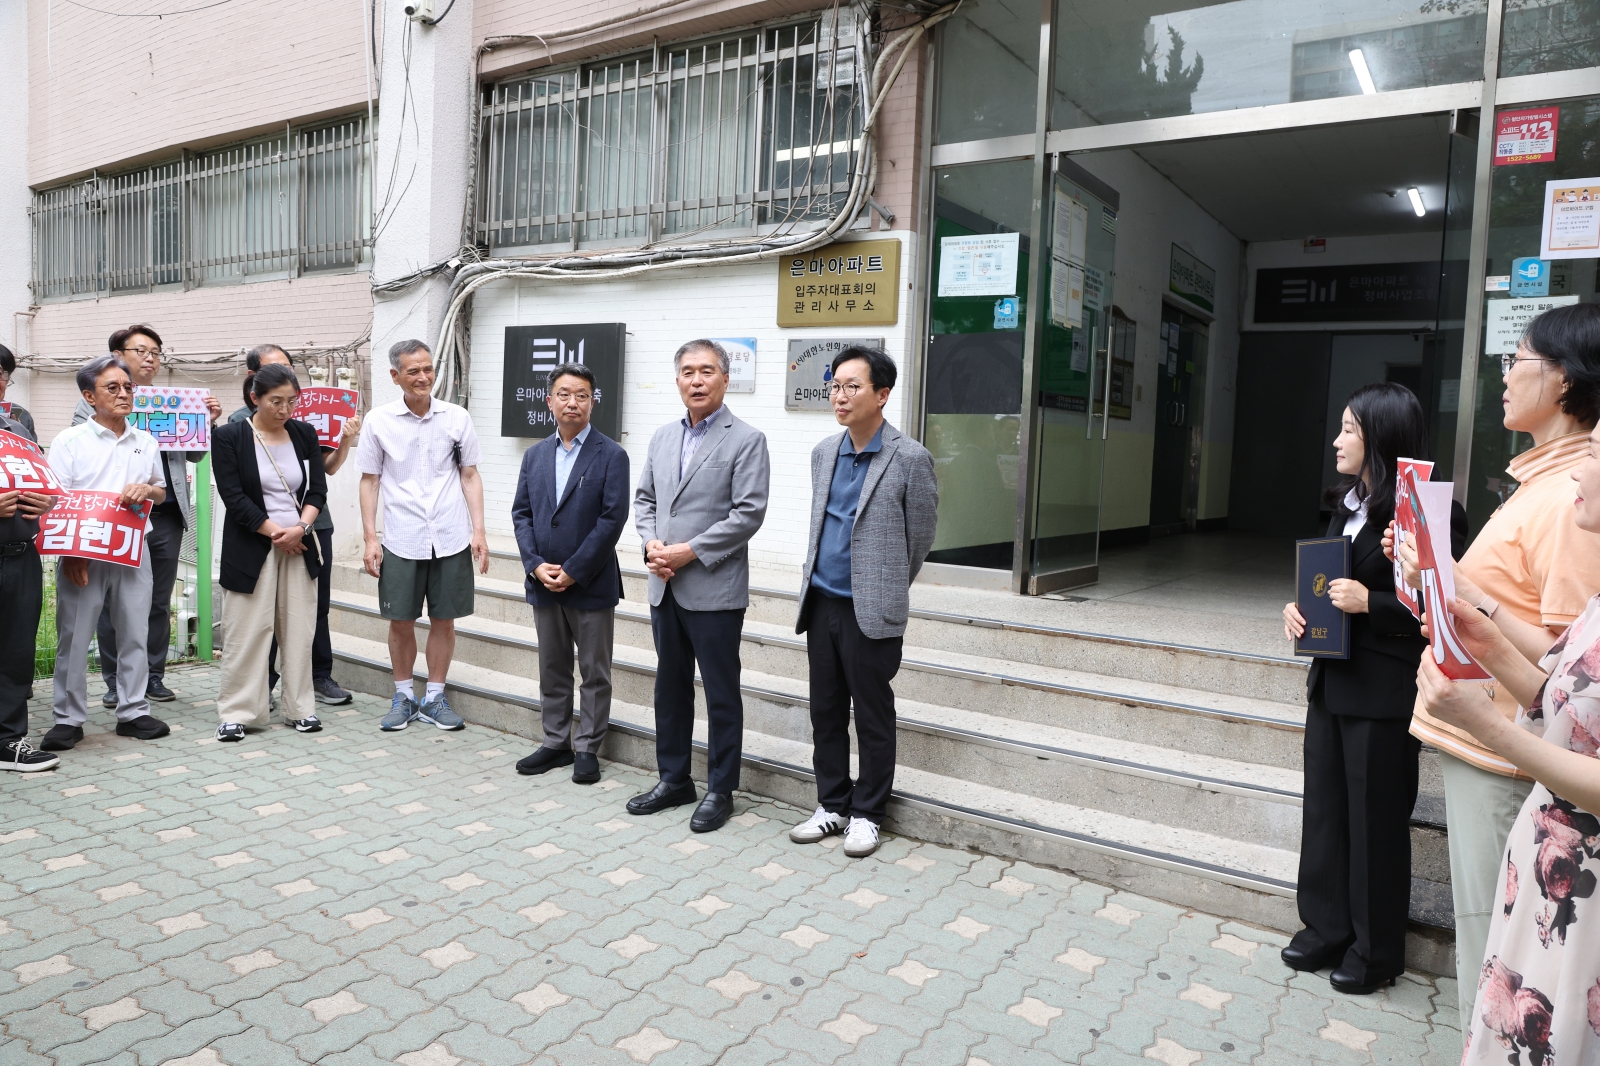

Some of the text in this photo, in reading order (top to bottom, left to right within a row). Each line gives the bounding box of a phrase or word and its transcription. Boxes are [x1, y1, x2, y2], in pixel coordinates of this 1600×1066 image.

[1501, 120, 1552, 140] 스피드 112
[1507, 153, 1542, 162] 1522-5689
[790, 255, 883, 277] 은마아파트
[1349, 275, 1409, 288] 은마아파트
[795, 282, 876, 297] 입주자대표회의
[515, 387, 548, 402] 은마아
[291, 412, 352, 443] 현기
[42, 517, 142, 562] 김현기
[1310, 627, 1328, 636] 강남구
